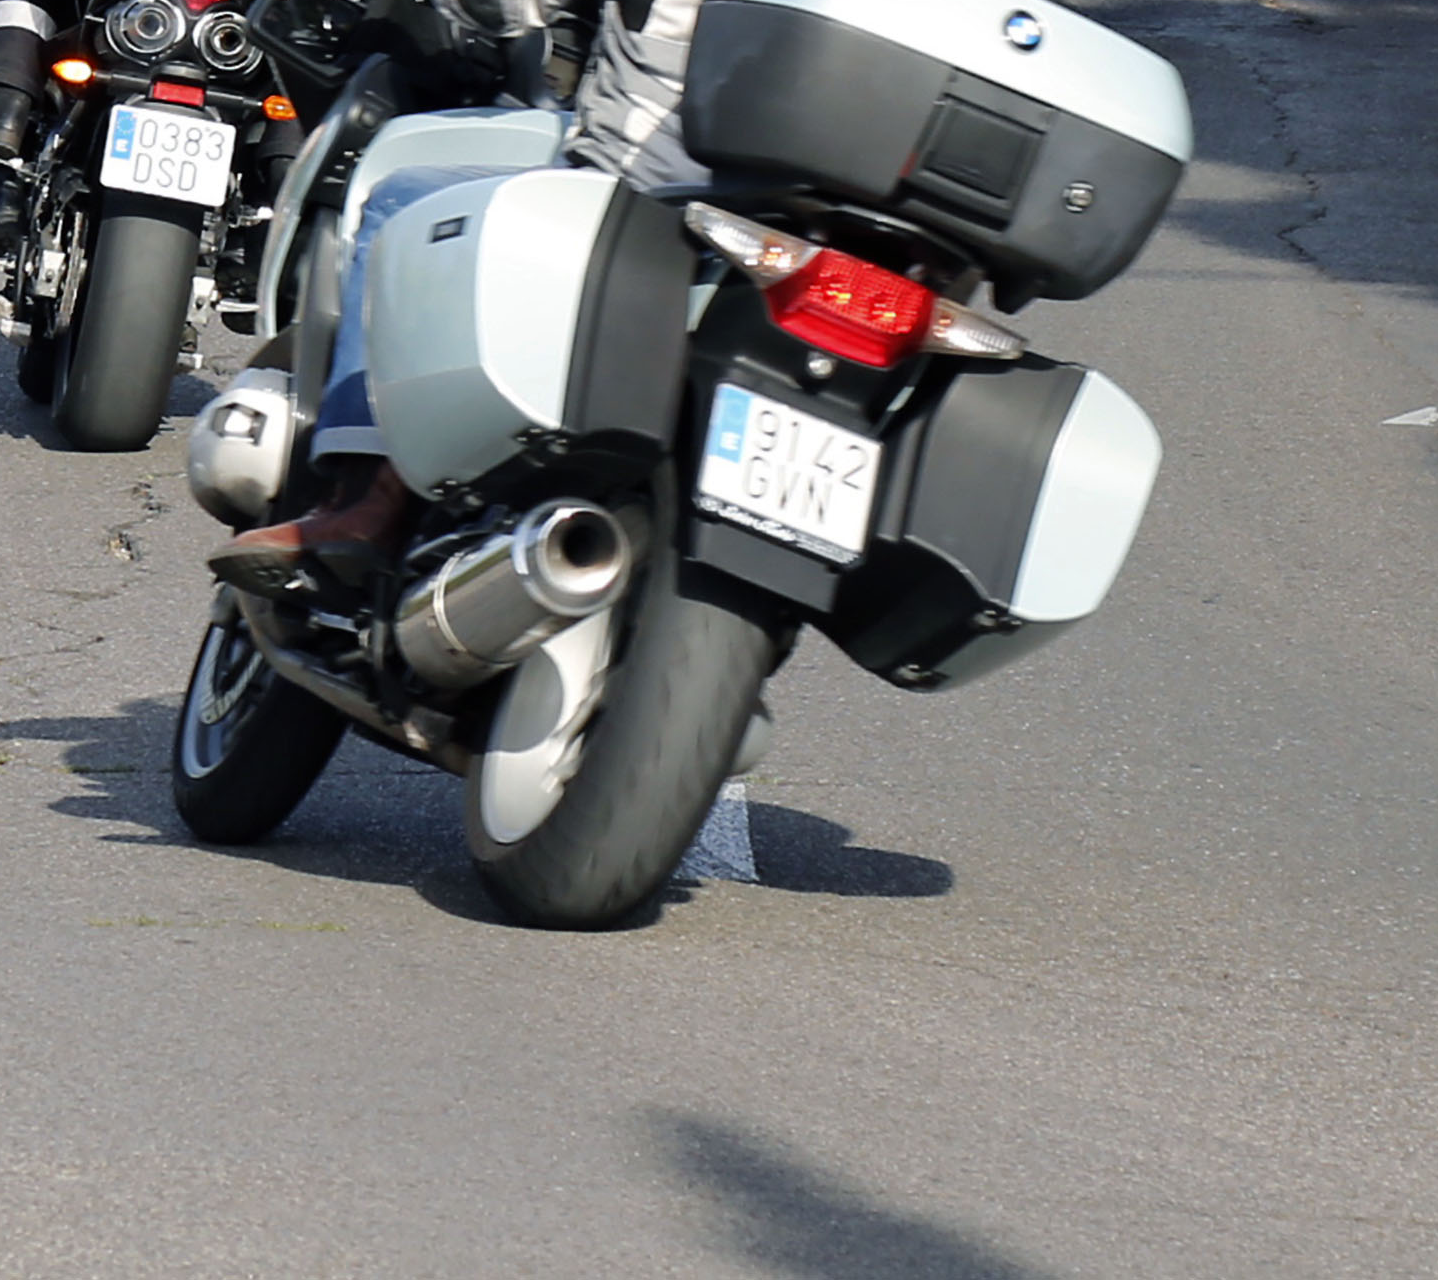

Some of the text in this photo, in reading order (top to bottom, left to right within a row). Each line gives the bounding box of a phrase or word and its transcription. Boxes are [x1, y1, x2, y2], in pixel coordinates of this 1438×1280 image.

[139, 118, 226, 161] 0383
[133, 152, 198, 192] DSD
[754, 409, 870, 491] 9142
[742, 454, 835, 525] GVN
